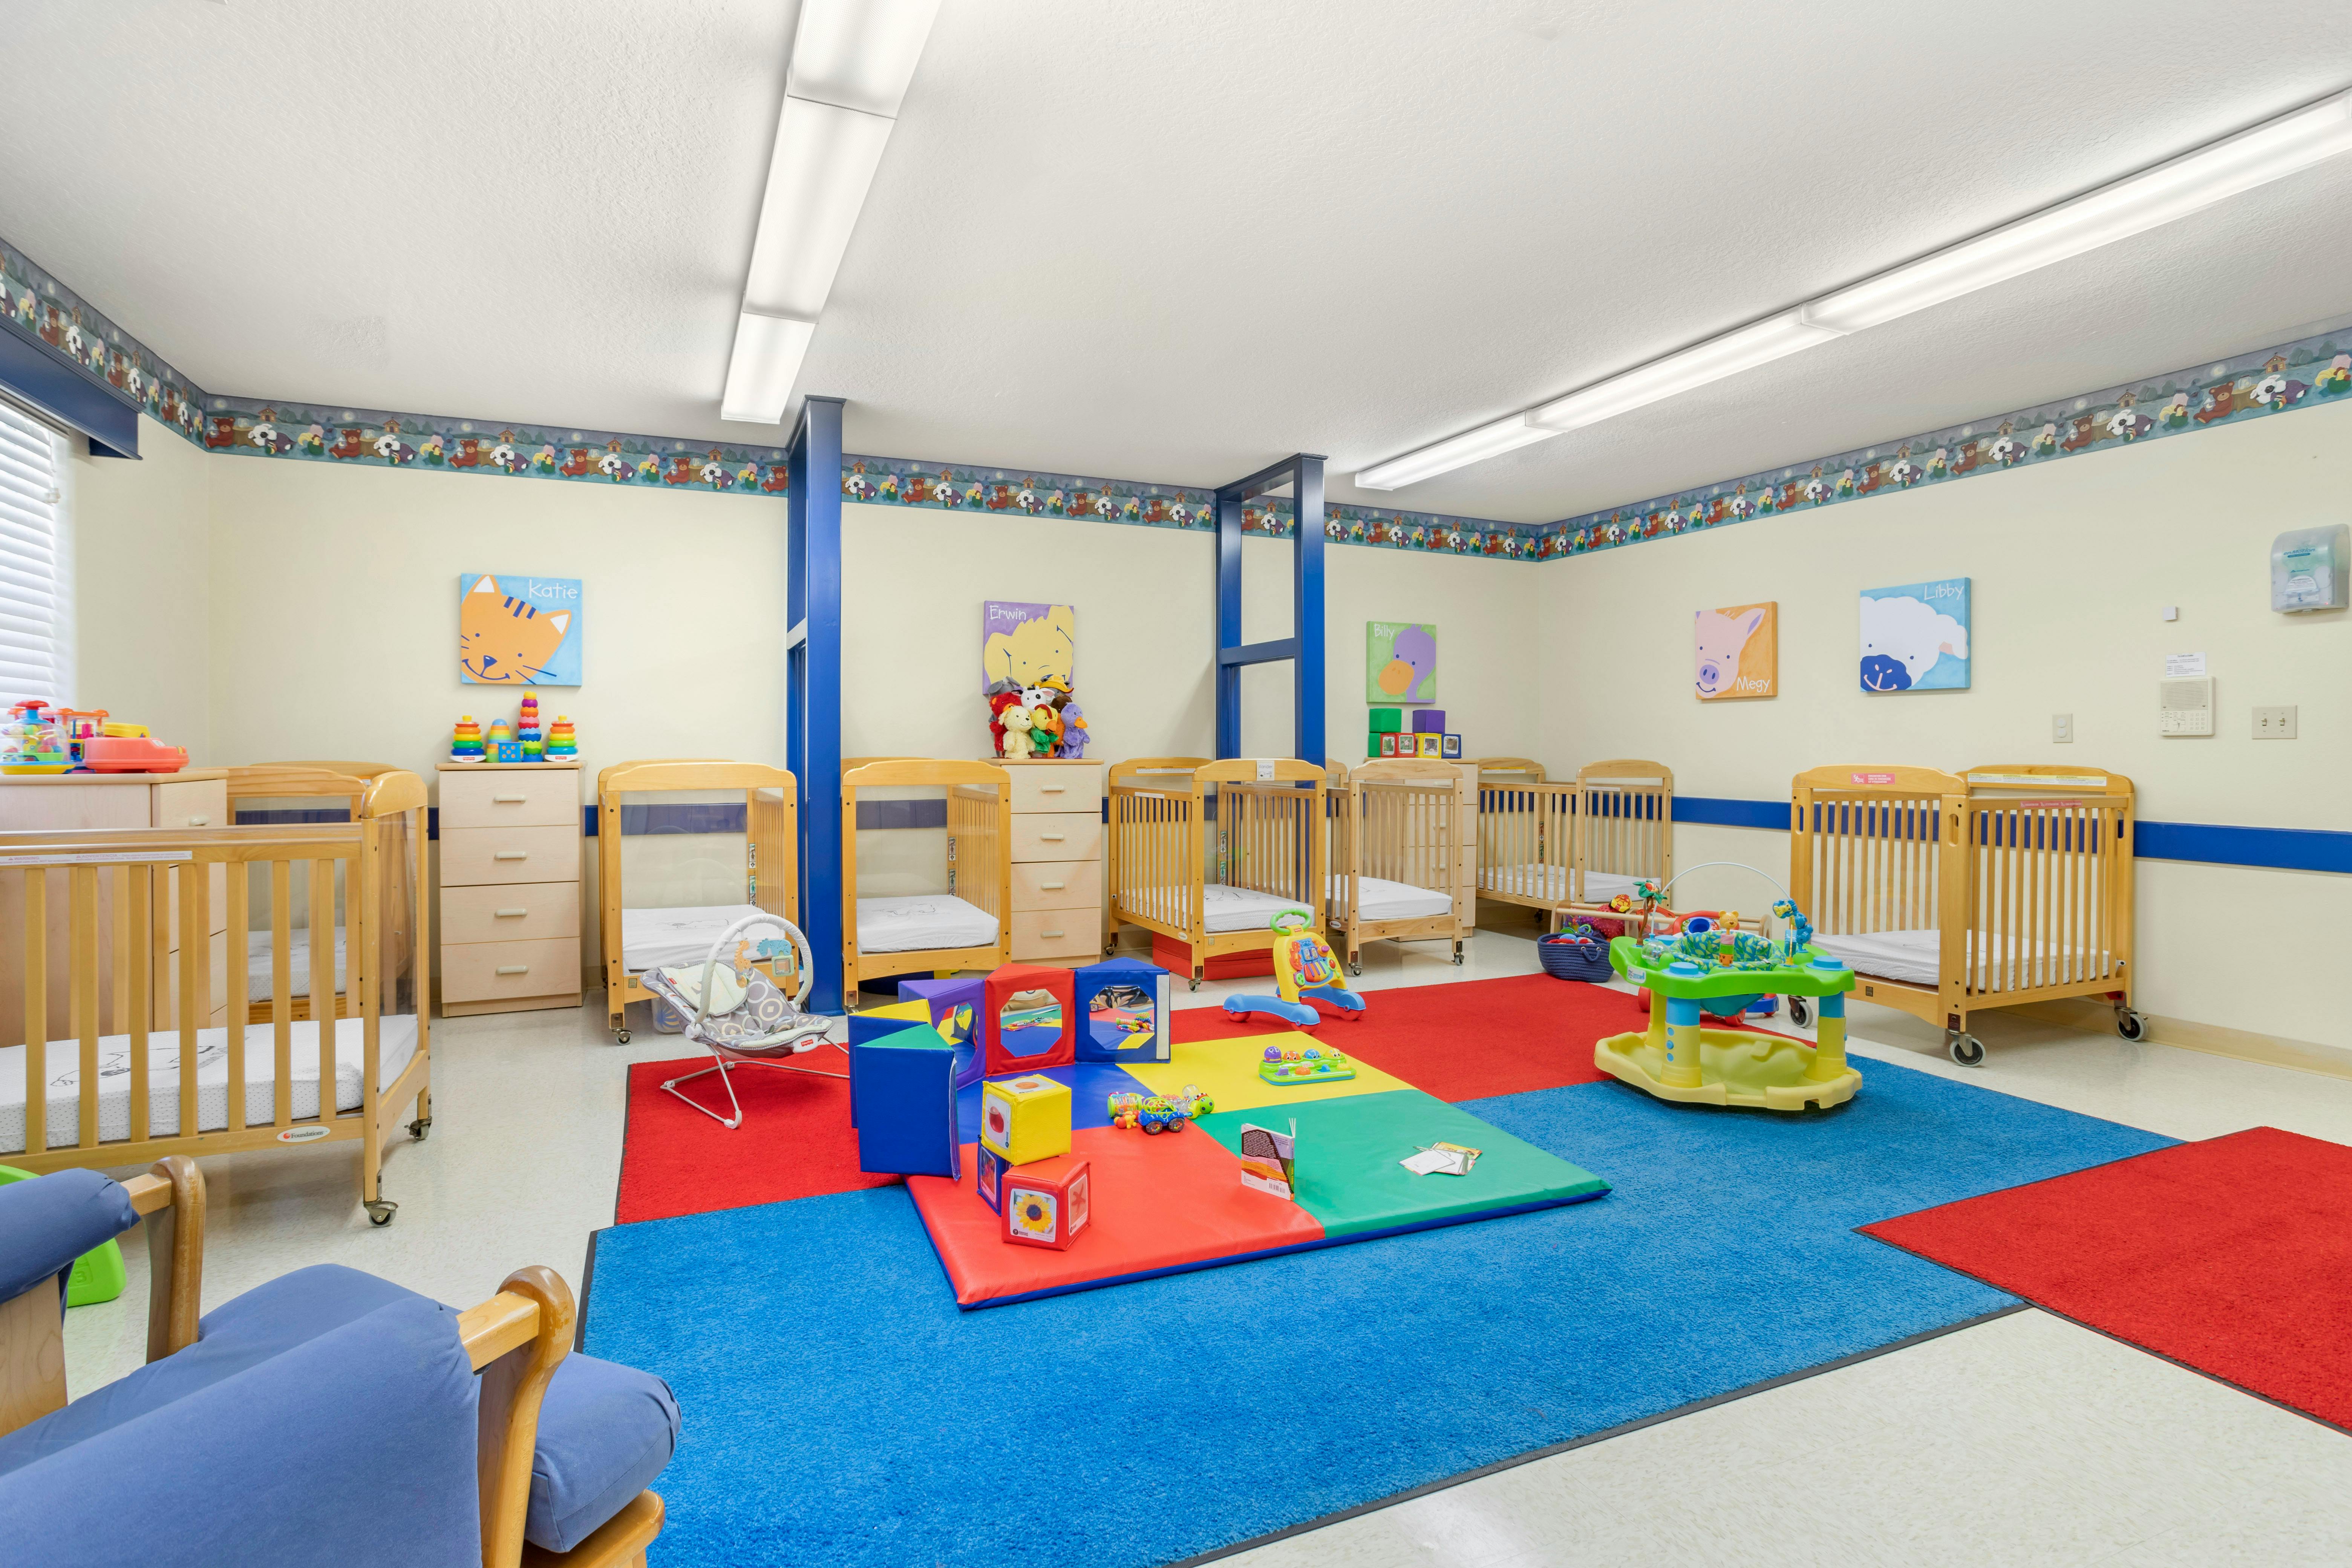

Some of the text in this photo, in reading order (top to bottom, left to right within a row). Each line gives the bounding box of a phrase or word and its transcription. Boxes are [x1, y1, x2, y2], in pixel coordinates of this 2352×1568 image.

[529, 579, 578, 599] Katie
[1924, 584, 1964, 600] Libby
[989, 605, 1026, 620] Erwin
[1374, 623, 1395, 640] Billy
[1736, 677, 1771, 693] Megy
